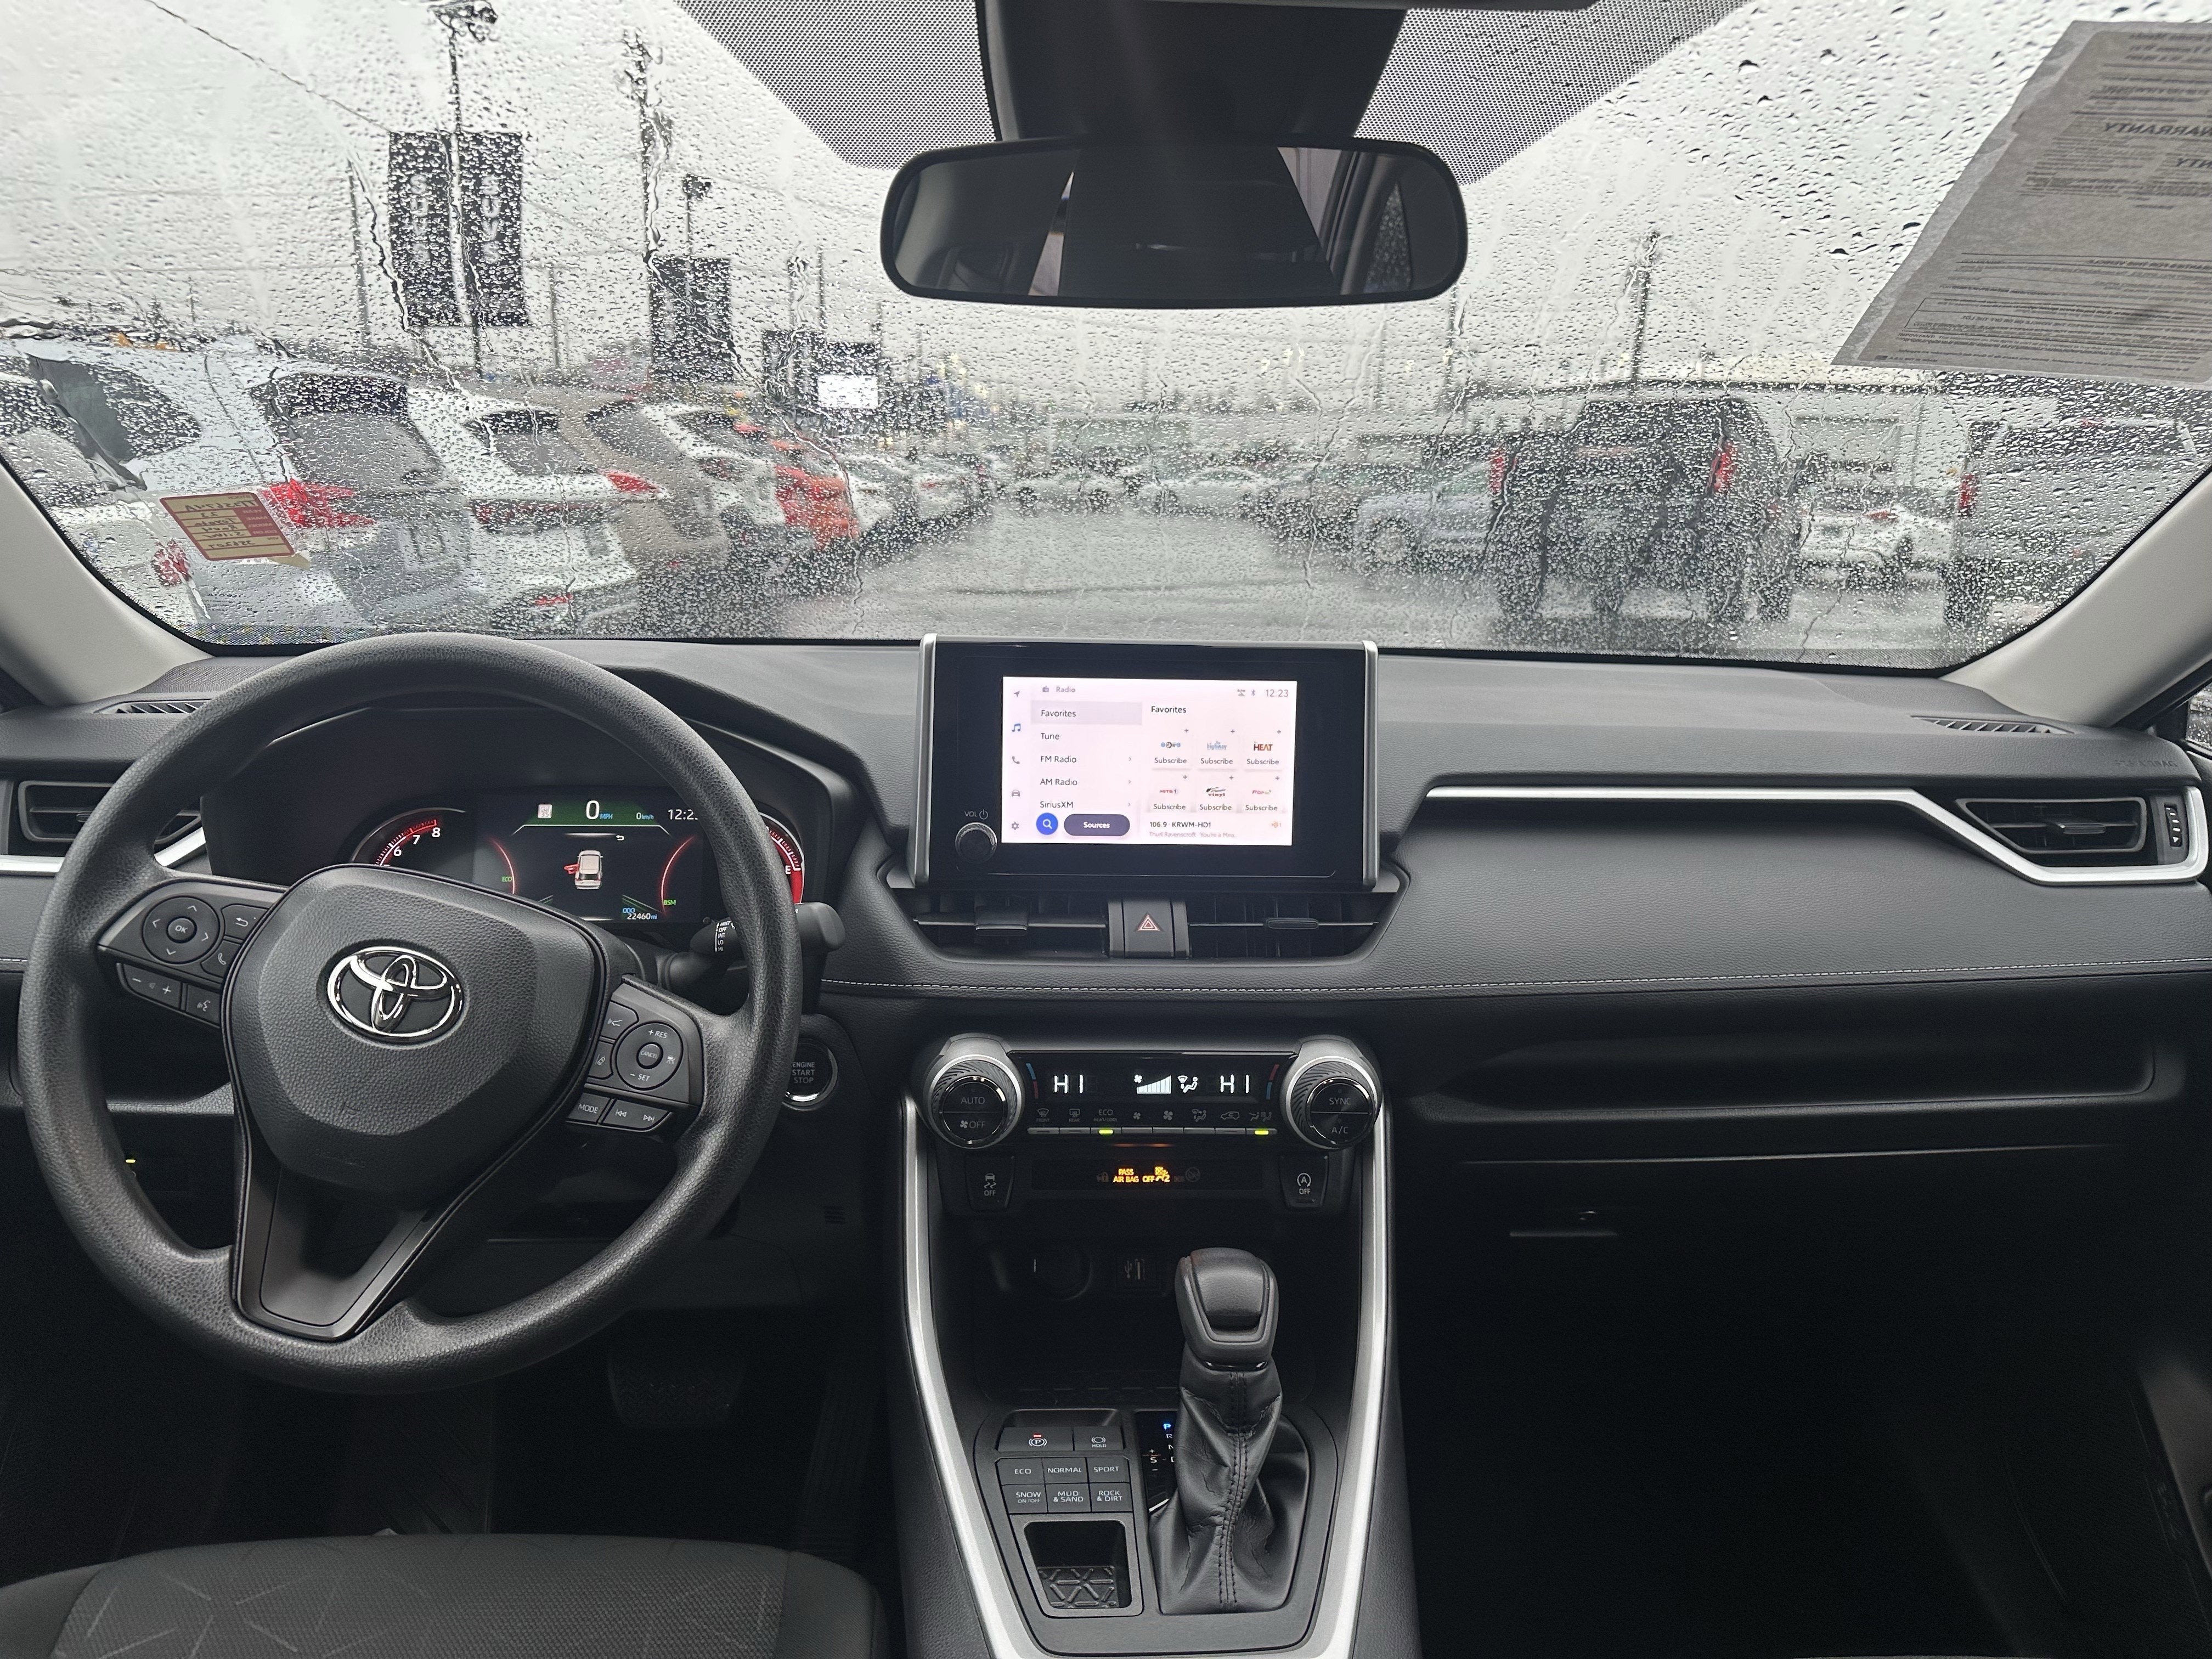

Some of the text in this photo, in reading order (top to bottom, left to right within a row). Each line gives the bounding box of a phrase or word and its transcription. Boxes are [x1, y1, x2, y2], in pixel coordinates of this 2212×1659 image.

[1151, 706, 1187, 714] Favorites
[586, 800, 600, 820] 0
[668, 809, 698, 821] 12:2
[1083, 821, 1111, 829] Sources
[432, 827, 441, 838] 8
[413, 834, 421, 845] 7
[393, 846, 402, 856] 6
[785, 865, 791, 874] E
[174, 925, 187, 933] OK
[654, 1030, 668, 1039] RES
[640, 1050, 658, 1059] CANCEL
[637, 1074, 650, 1082] SET
[578, 1103, 599, 1114] MODE
[969, 1121, 985, 1129] OFF
[1331, 1126, 1348, 1135] A/C
